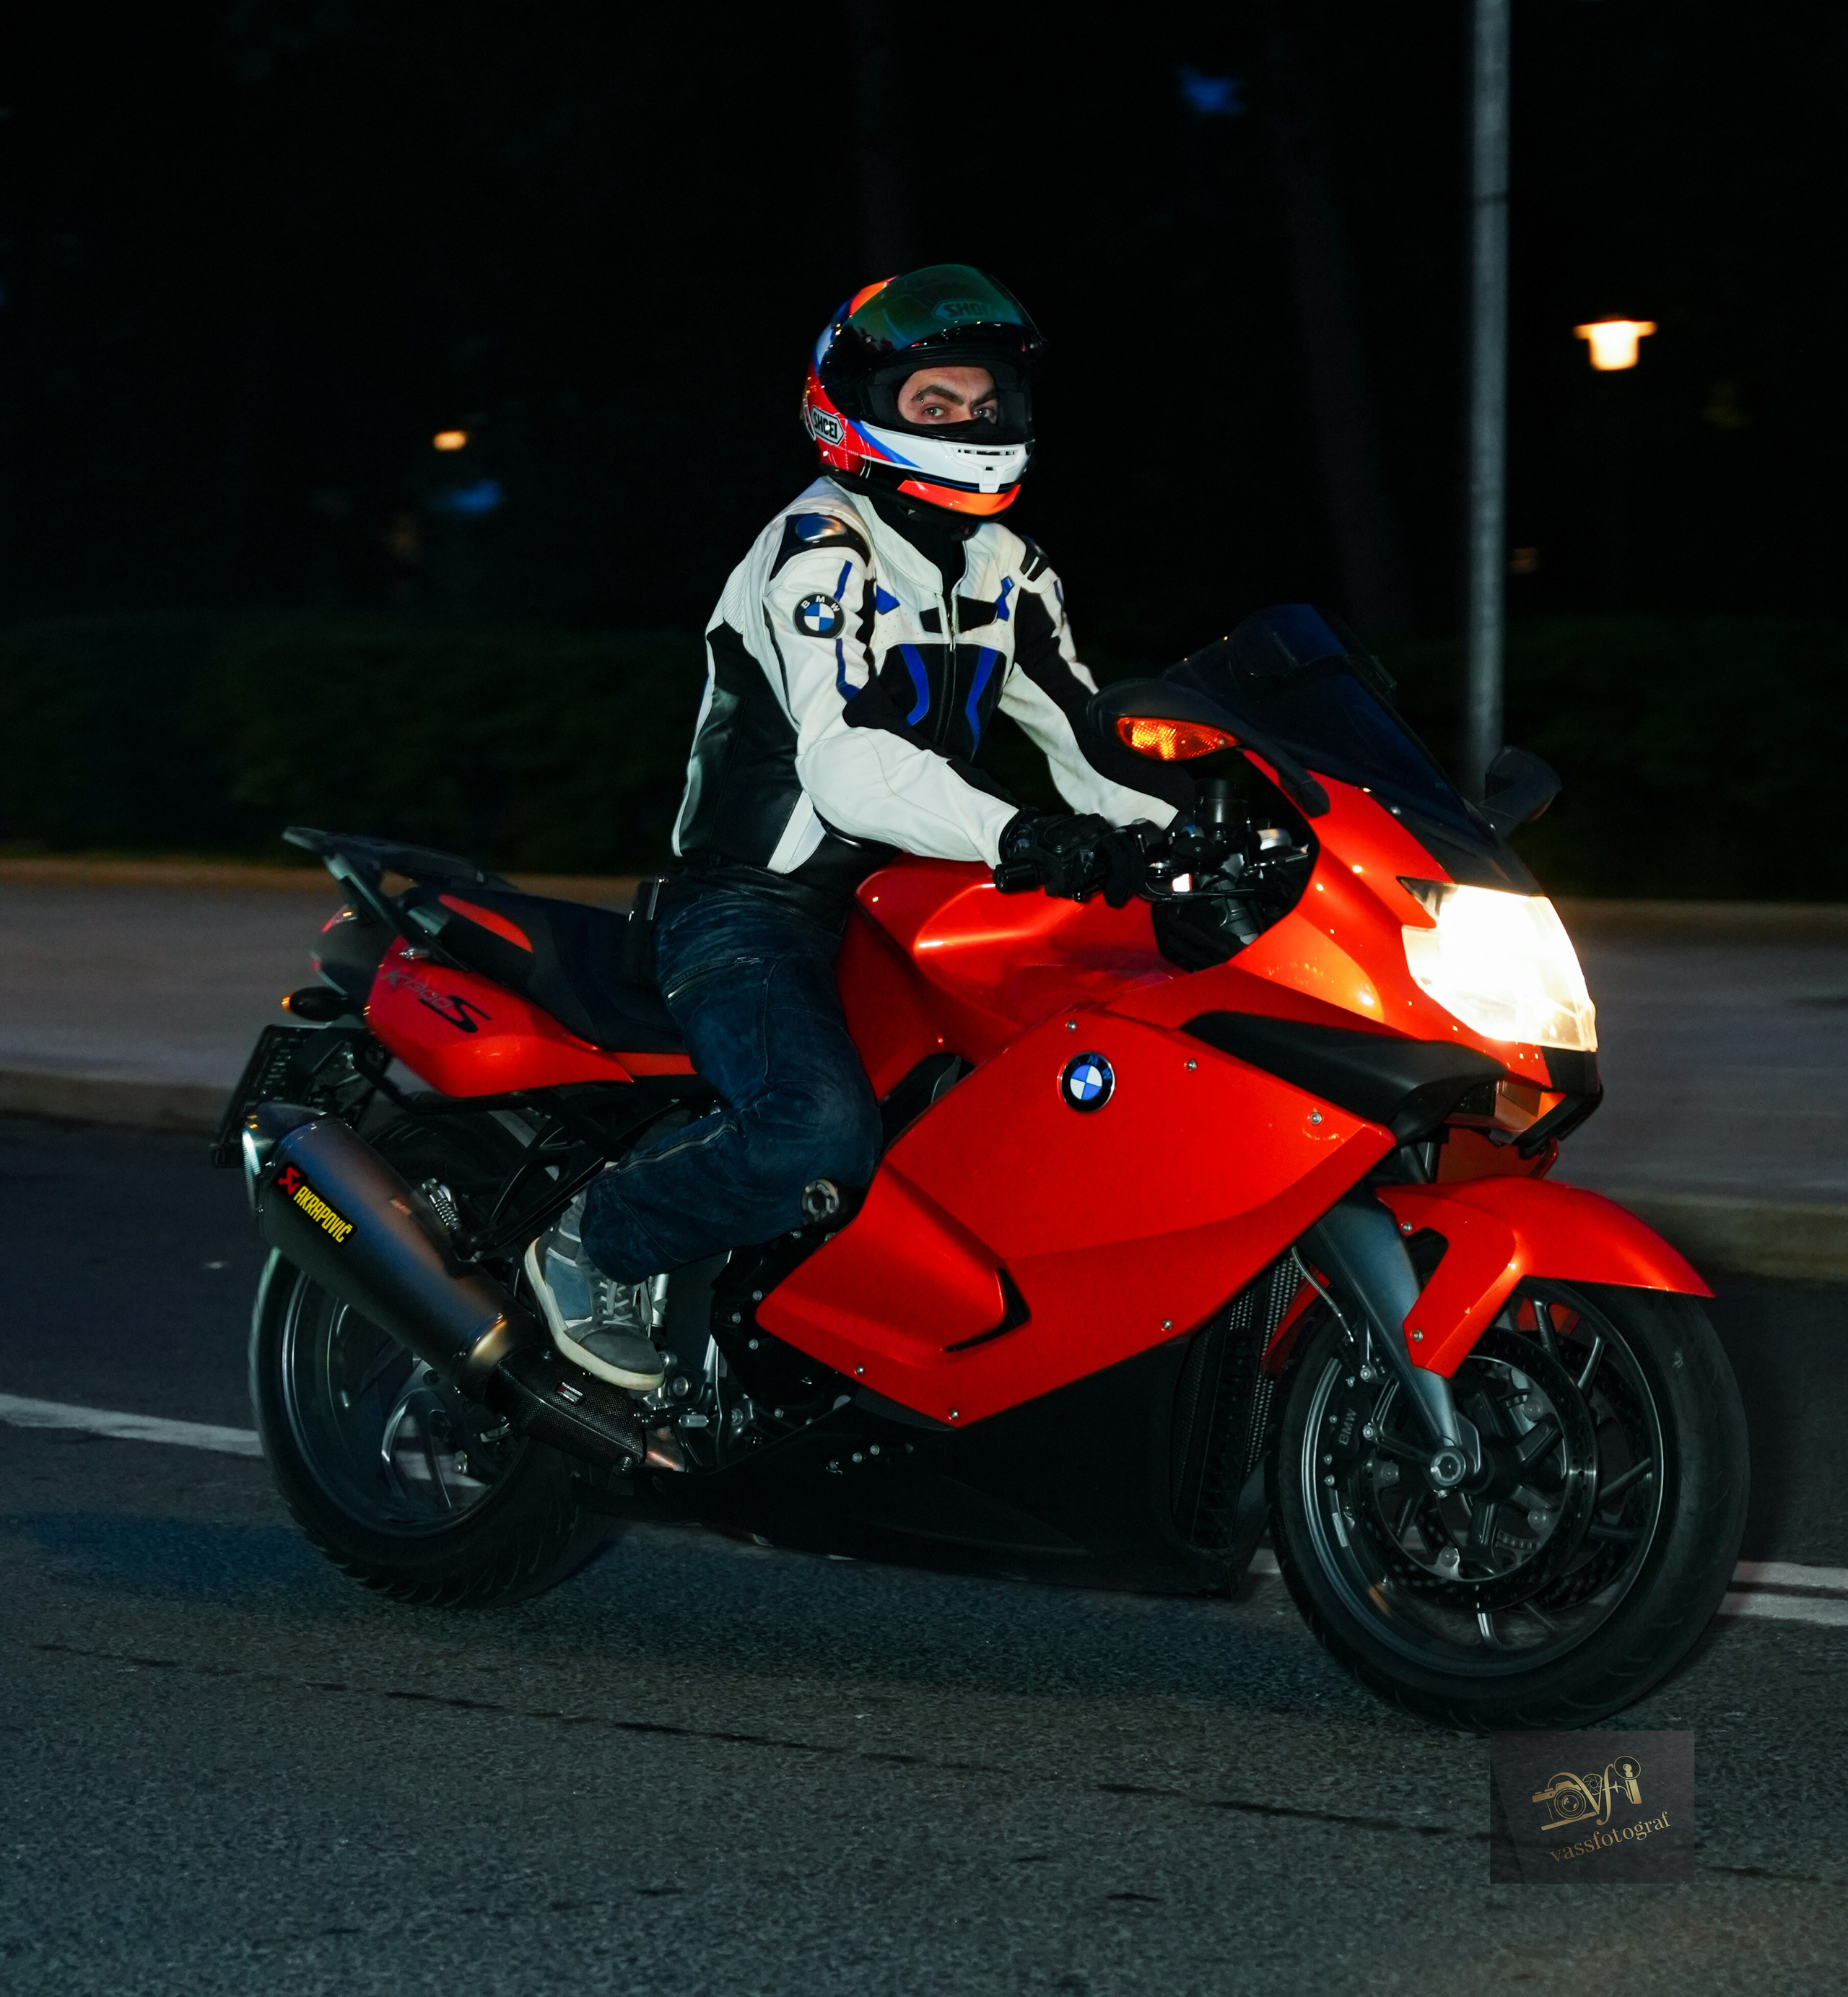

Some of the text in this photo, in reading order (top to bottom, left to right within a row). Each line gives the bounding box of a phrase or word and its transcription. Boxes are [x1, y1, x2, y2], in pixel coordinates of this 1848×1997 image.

[814, 411, 837, 440] SHOEI
[801, 595, 840, 612] BMW
[1338, 1408, 1357, 1445] BMW
